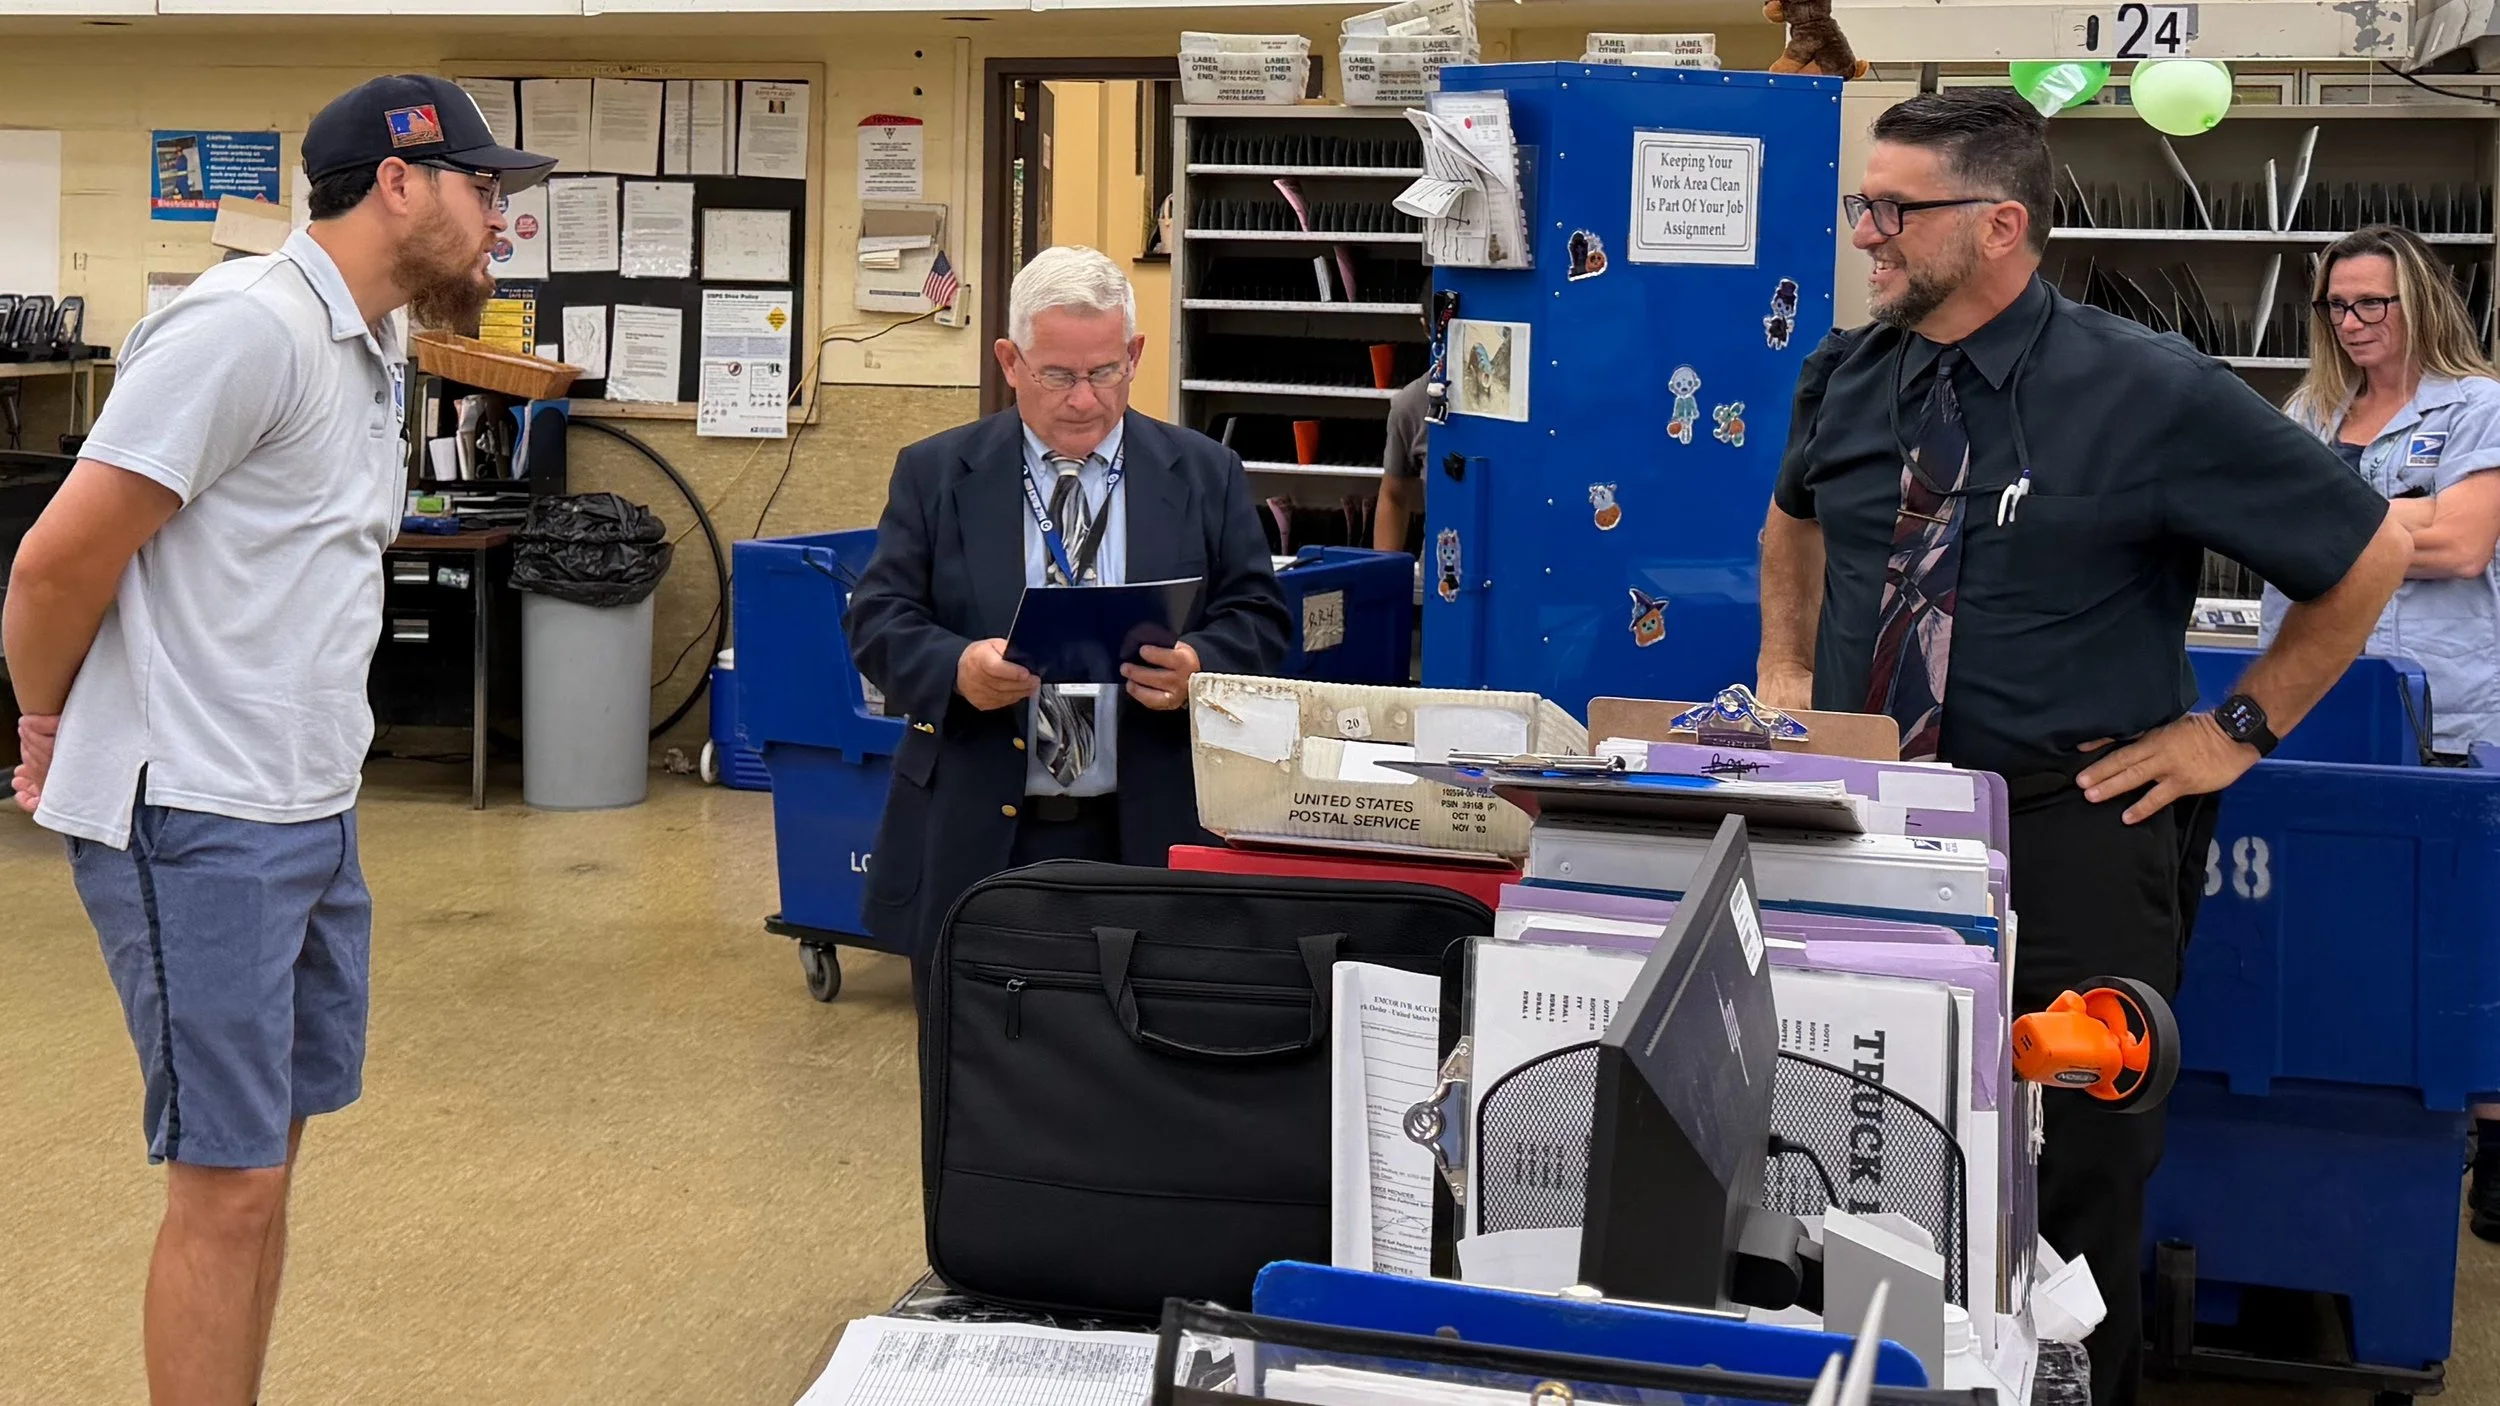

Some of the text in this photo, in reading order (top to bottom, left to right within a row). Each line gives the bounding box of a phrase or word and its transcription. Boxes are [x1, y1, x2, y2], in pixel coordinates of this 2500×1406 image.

[2116, 3, 2180, 58] 24
[1661, 152, 1733, 172] Keeping Your
[1652, 175, 1740, 191] Work Area Clean
[1646, 198, 1744, 217] Is Part Of Your Job
[1663, 221, 1726, 239] Assignment
[1346, 718, 1360, 730] 20
[1293, 793, 1414, 813] UNITED STATES
[1288, 810, 1421, 831] POSTAL SERVICE
[1452, 812, 1469, 820] OCT
[1452, 824, 1469, 832] NOV
[1850, 1030, 1886, 1185] TRUCK
